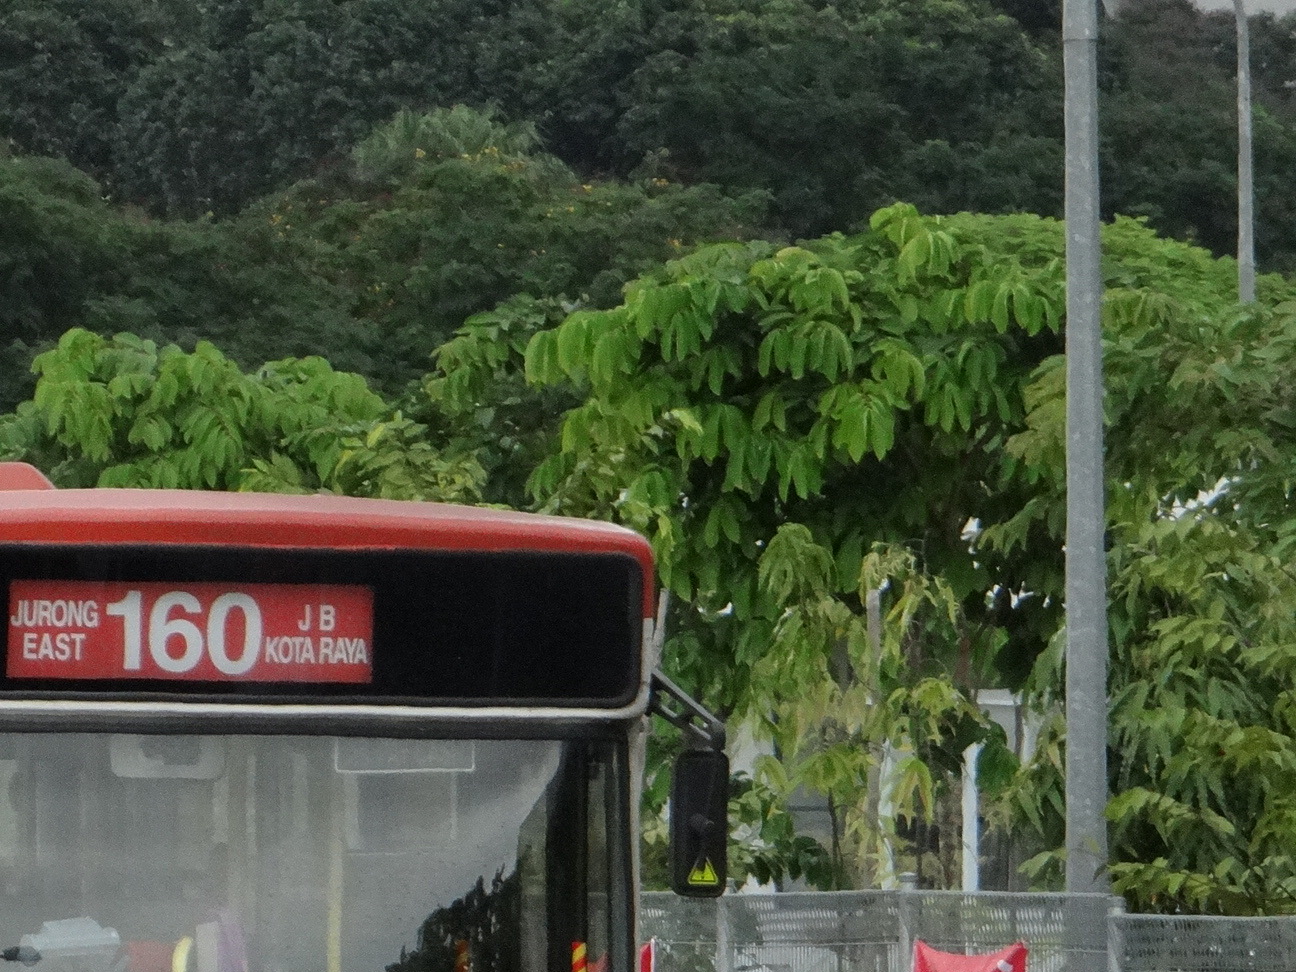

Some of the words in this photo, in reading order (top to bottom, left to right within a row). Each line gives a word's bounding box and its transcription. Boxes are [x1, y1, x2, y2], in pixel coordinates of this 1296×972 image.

[10, 599, 100, 628] JURONG
[22, 632, 86, 661] EAST
[106, 590, 262, 675] 160
[265, 636, 315, 663] KOTA
[319, 636, 368, 664] RAYA
